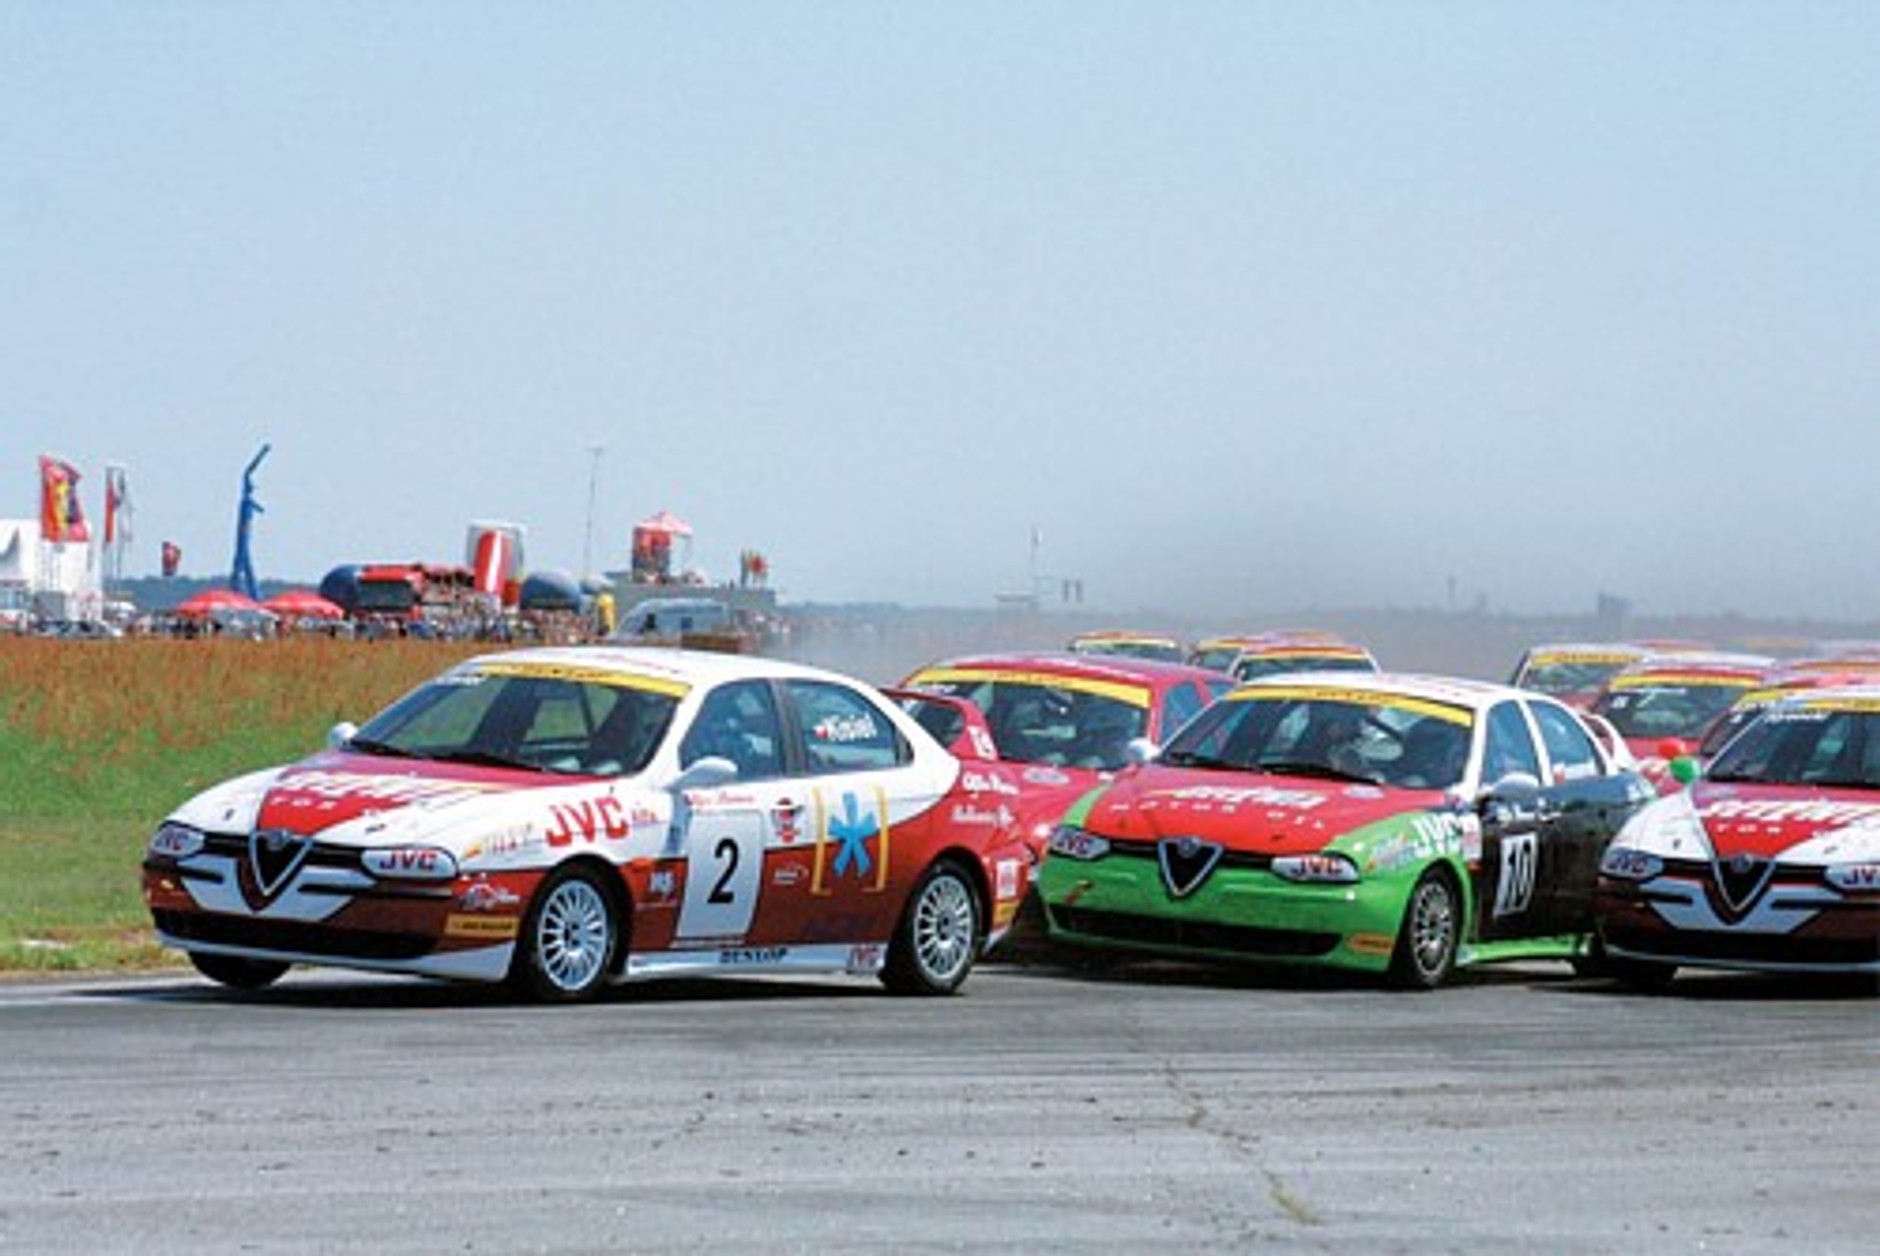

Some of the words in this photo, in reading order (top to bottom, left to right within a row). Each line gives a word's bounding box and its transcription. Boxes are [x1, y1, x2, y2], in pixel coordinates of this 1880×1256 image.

[545, 797, 629, 846] JVC
[379, 850, 437, 871] JVC
[707, 837, 739, 904] 2
